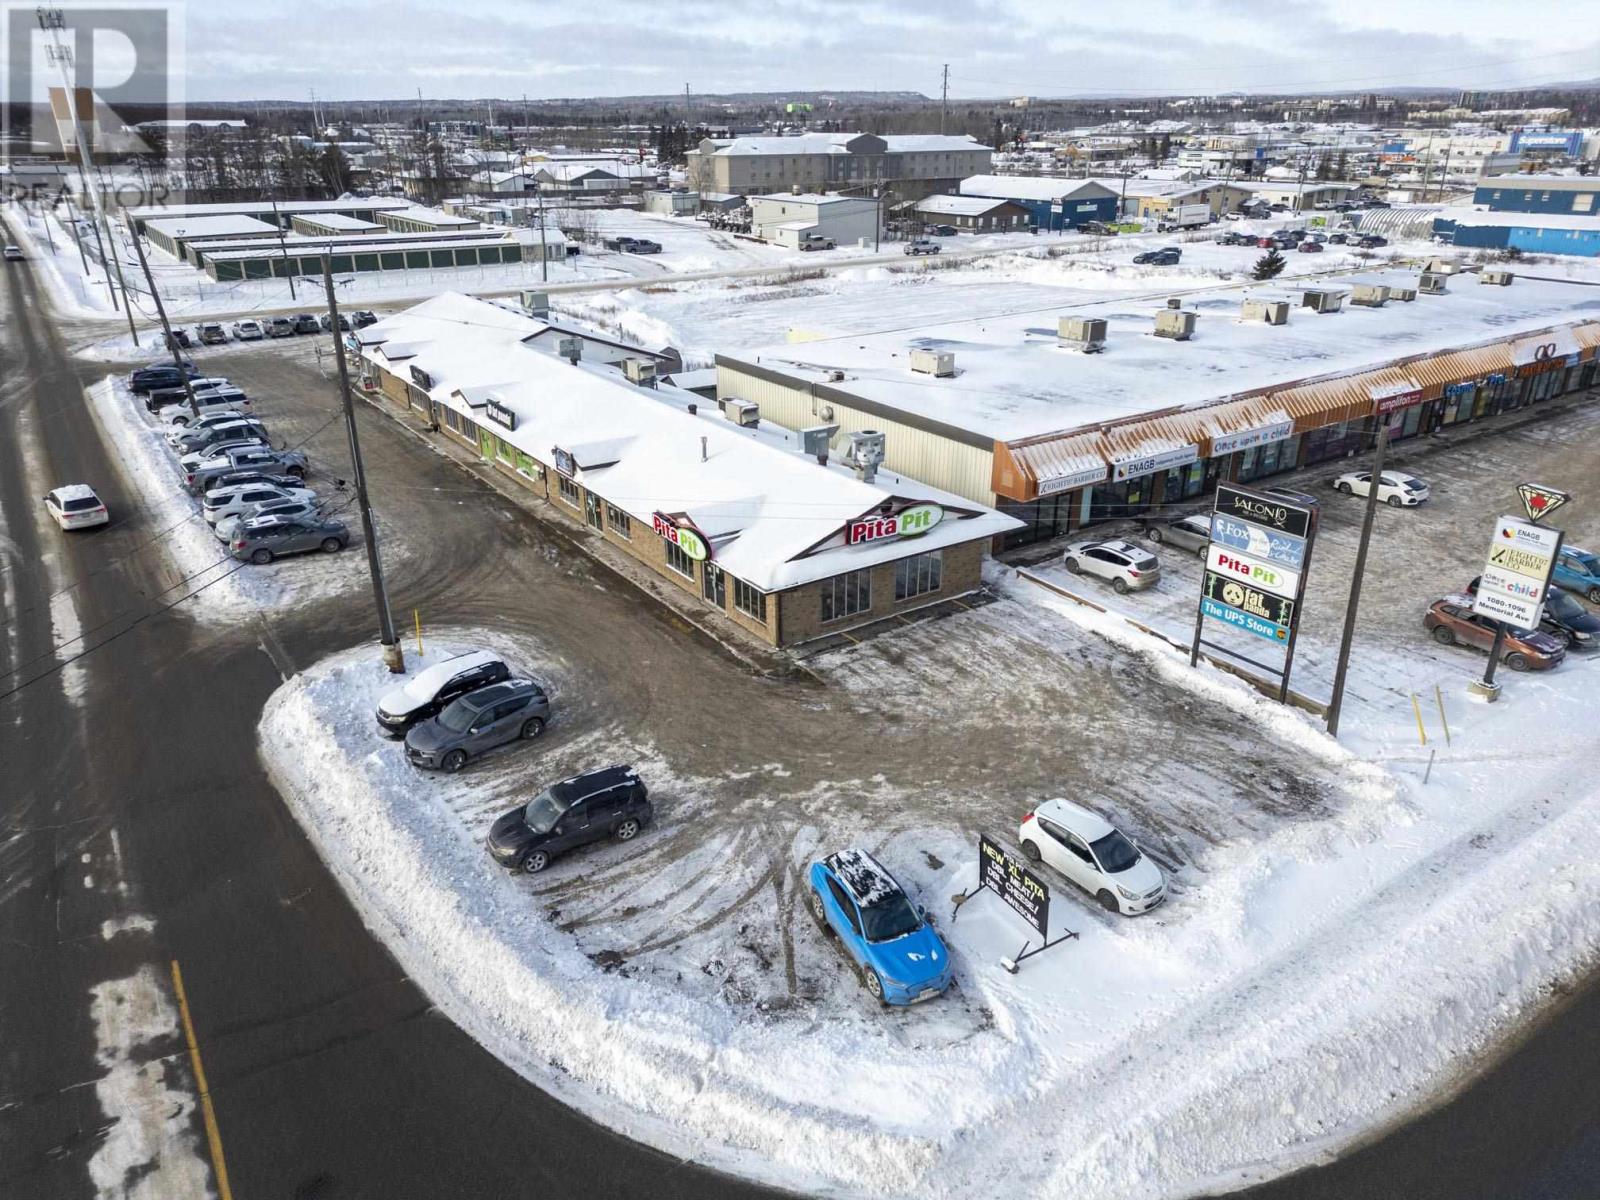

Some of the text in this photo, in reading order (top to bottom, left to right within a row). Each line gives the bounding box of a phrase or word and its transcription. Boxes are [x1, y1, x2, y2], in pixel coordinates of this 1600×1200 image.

[1214, 440, 1238, 453] Once
[1240, 434, 1260, 446] upon
[1271, 423, 1291, 439] child
[1128, 459, 1155, 474] ENAGB
[652, 514, 699, 556] Pita Pit
[850, 510, 932, 545] Pita Pit
[1225, 521, 1249, 540] Fox
[1517, 529, 1541, 541] ENAGB
[1218, 553, 1278, 585] Pita Pit
[1506, 561, 1520, 571] CO
[1508, 555, 1542, 572] BARBER
[1244, 587, 1263, 608] fat
[1507, 583, 1538, 598] child
[1205, 601, 1274, 637] The UPS Store
[1243, 602, 1270, 619] panda
[1478, 601, 1530, 622] Memorial Ave
[983, 842, 1045, 902] NEW XL PITA
[987, 866, 1003, 885] DBL
[991, 860, 1007, 878] DBL
[985, 876, 1040, 930] DBL AWESOME
